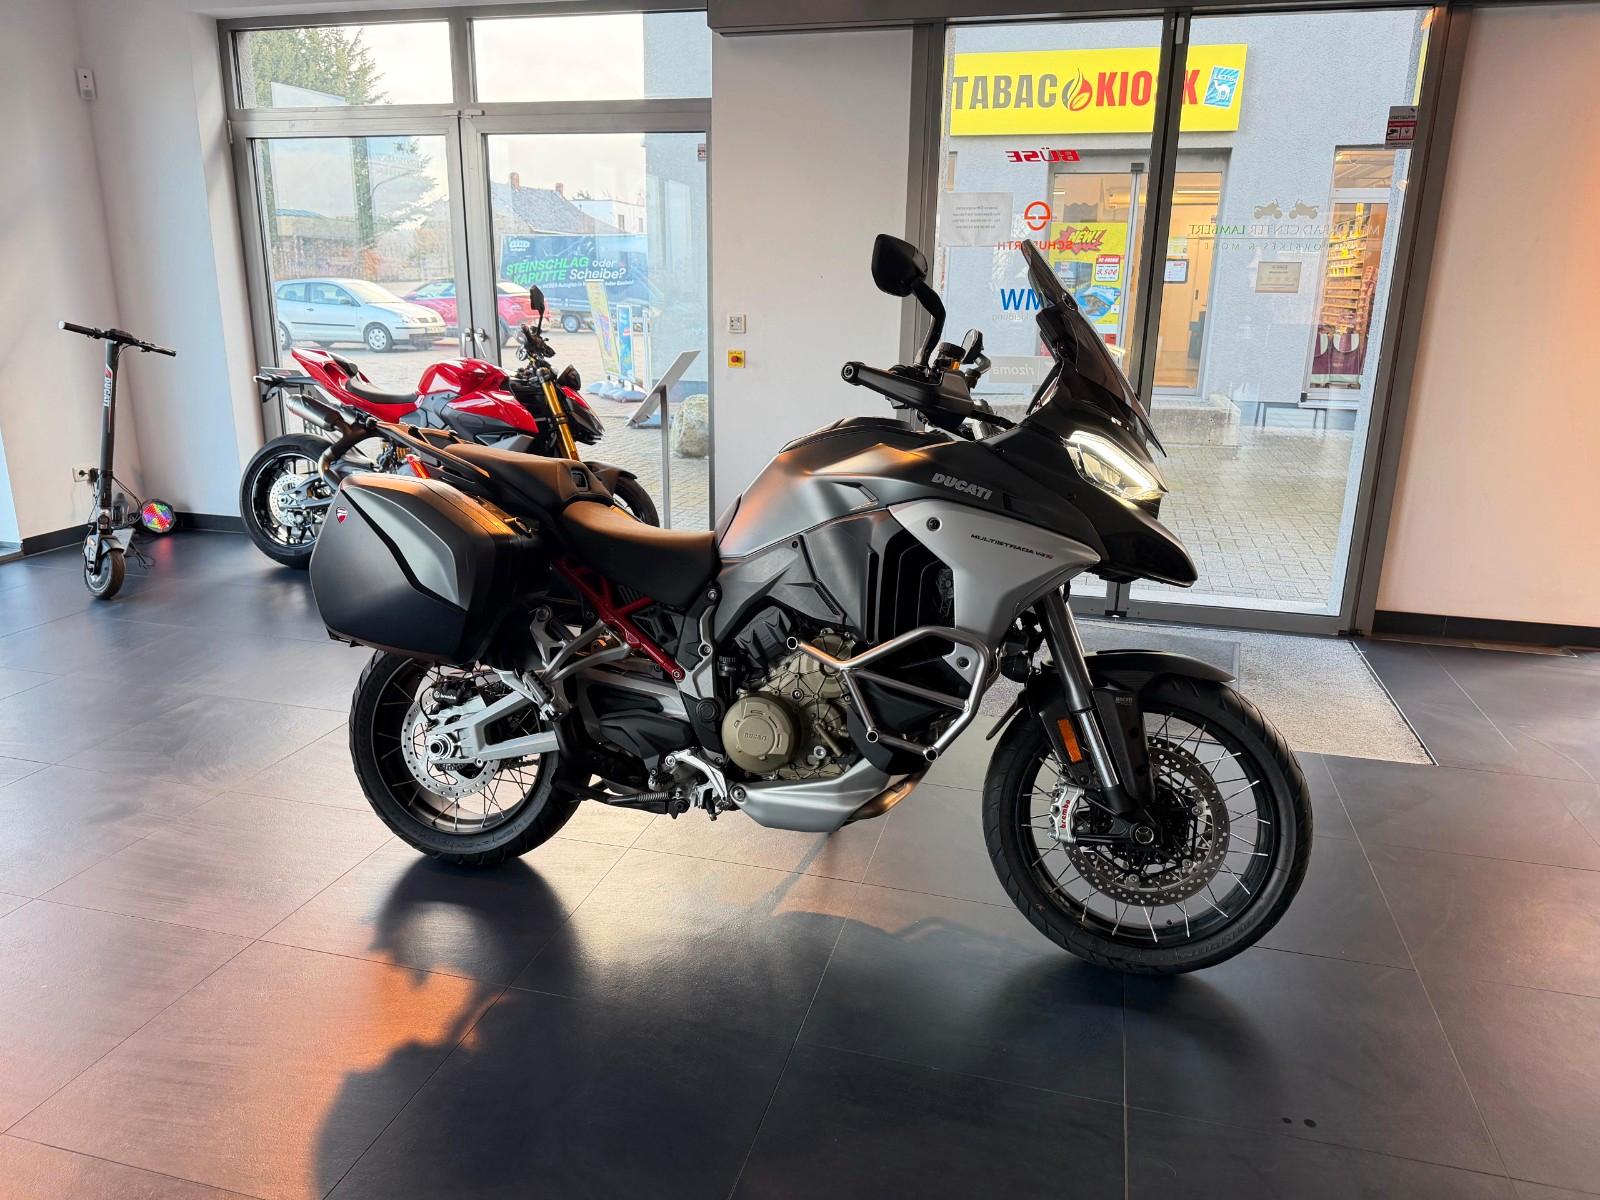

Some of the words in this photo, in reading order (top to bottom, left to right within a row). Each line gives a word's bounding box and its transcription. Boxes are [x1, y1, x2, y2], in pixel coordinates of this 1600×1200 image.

[951, 74, 1058, 110] TABAC
[1095, 69, 1201, 108] KIOK
[506, 257, 588, 276] STEINSCHLAG
[592, 259, 617, 268] oder
[513, 269, 567, 285] KAPUTTE
[569, 267, 626, 280] Scheibe?
[931, 472, 993, 500] DUCATI
[970, 533, 1034, 555] MULTISTRADA
[1059, 799, 1071, 829] brembo
